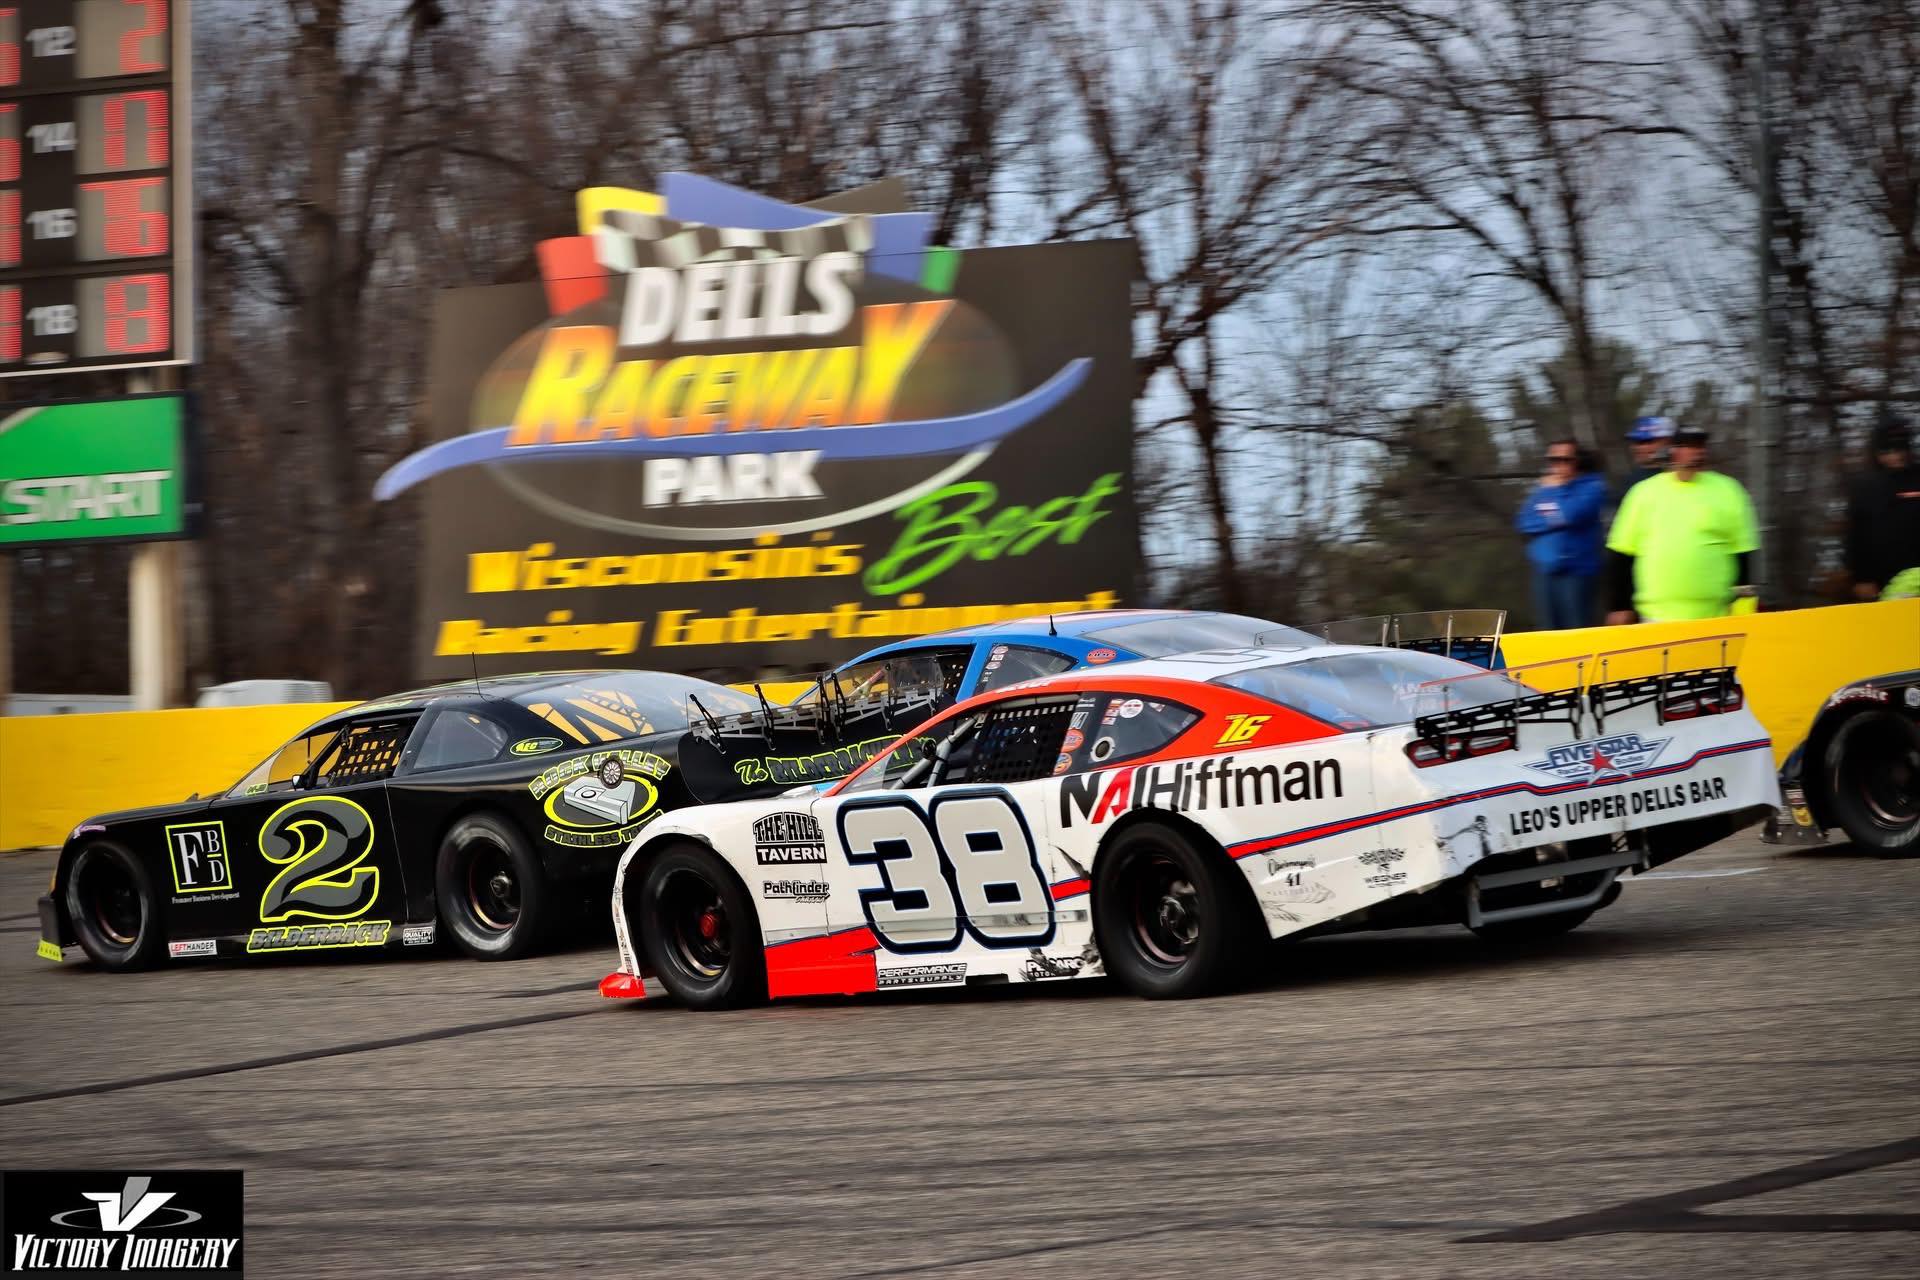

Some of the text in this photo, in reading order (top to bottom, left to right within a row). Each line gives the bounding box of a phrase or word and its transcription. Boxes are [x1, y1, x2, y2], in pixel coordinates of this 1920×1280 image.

[617, 252, 862, 346] DELLS
[504, 299, 957, 446] RACEWAY
[643, 450, 826, 508] PARK
[2, 470, 173, 525] START
[467, 472, 1124, 596] Wisconsin's Best
[434, 609, 646, 656] Racing
[1216, 714, 1272, 746] 16
[1550, 735, 1645, 768] FIVE STAR
[528, 755, 591, 800] ROCK
[735, 758, 768, 784] The
[1148, 756, 1343, 812] Hiffman
[1510, 777, 1728, 836] LEO'S UPPER DELLS BAR
[544, 824, 622, 848] STAINLESS
[753, 812, 823, 842] THE HILL
[258, 795, 380, 923] 2
[757, 846, 826, 862] TAVERN
[836, 785, 1057, 955] 38
[763, 880, 830, 896] Pathfinder
[1285, 872, 1301, 886] 41
[1364, 872, 1407, 884] WEGNER
[171, 941, 214, 952] LEFTHANDER
[248, 920, 390, 952] BILDERBACK
[404, 931, 431, 939] QUALITY
[878, 963, 967, 978] PERFORMANCE
